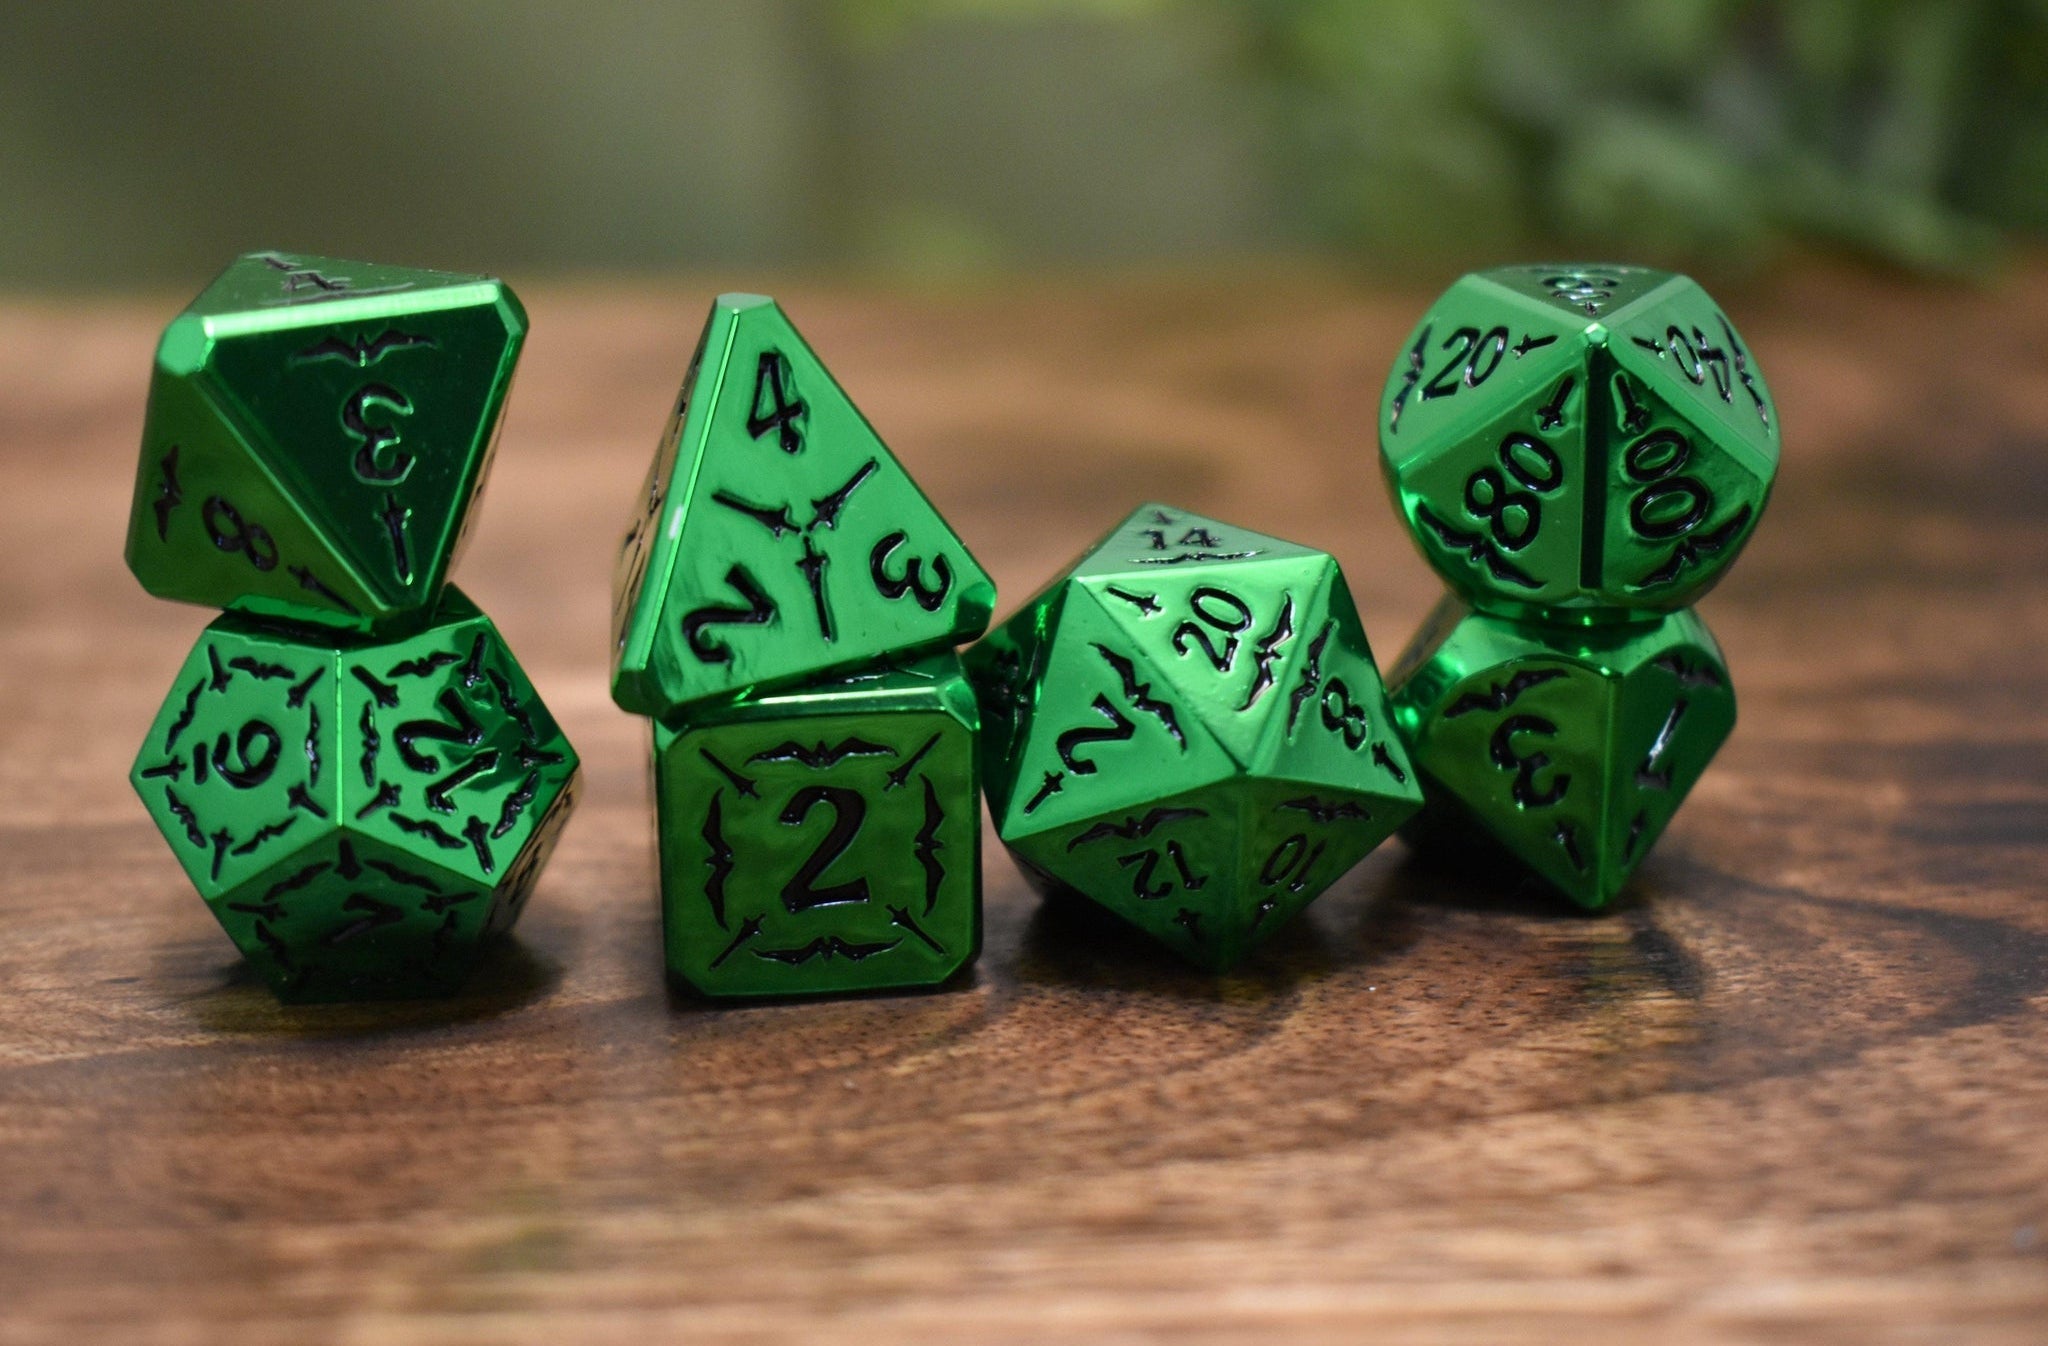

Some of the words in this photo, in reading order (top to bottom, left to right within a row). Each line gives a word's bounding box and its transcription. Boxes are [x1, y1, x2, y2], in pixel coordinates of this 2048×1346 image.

[747, 346, 809, 455] 4
[1418, 326, 1510, 401] 20
[1667, 324, 1732, 404] 40
[343, 384, 416, 484] 3
[1464, 432, 1564, 552] 80
[1624, 429, 1710, 540] 00
[203, 496, 279, 572] 8
[870, 528, 955, 613] 3
[1143, 527, 1221, 550] 14
[682, 563, 779, 663] 2
[1171, 586, 1253, 673] 20
[394, 688, 501, 814] 12
[1056, 691, 1137, 776] 2
[1320, 677, 1368, 752] 8
[1490, 714, 1571, 810] 3
[779, 785, 871, 914] 2
[1118, 839, 1208, 900] 12
[1260, 833, 1328, 893] 10
